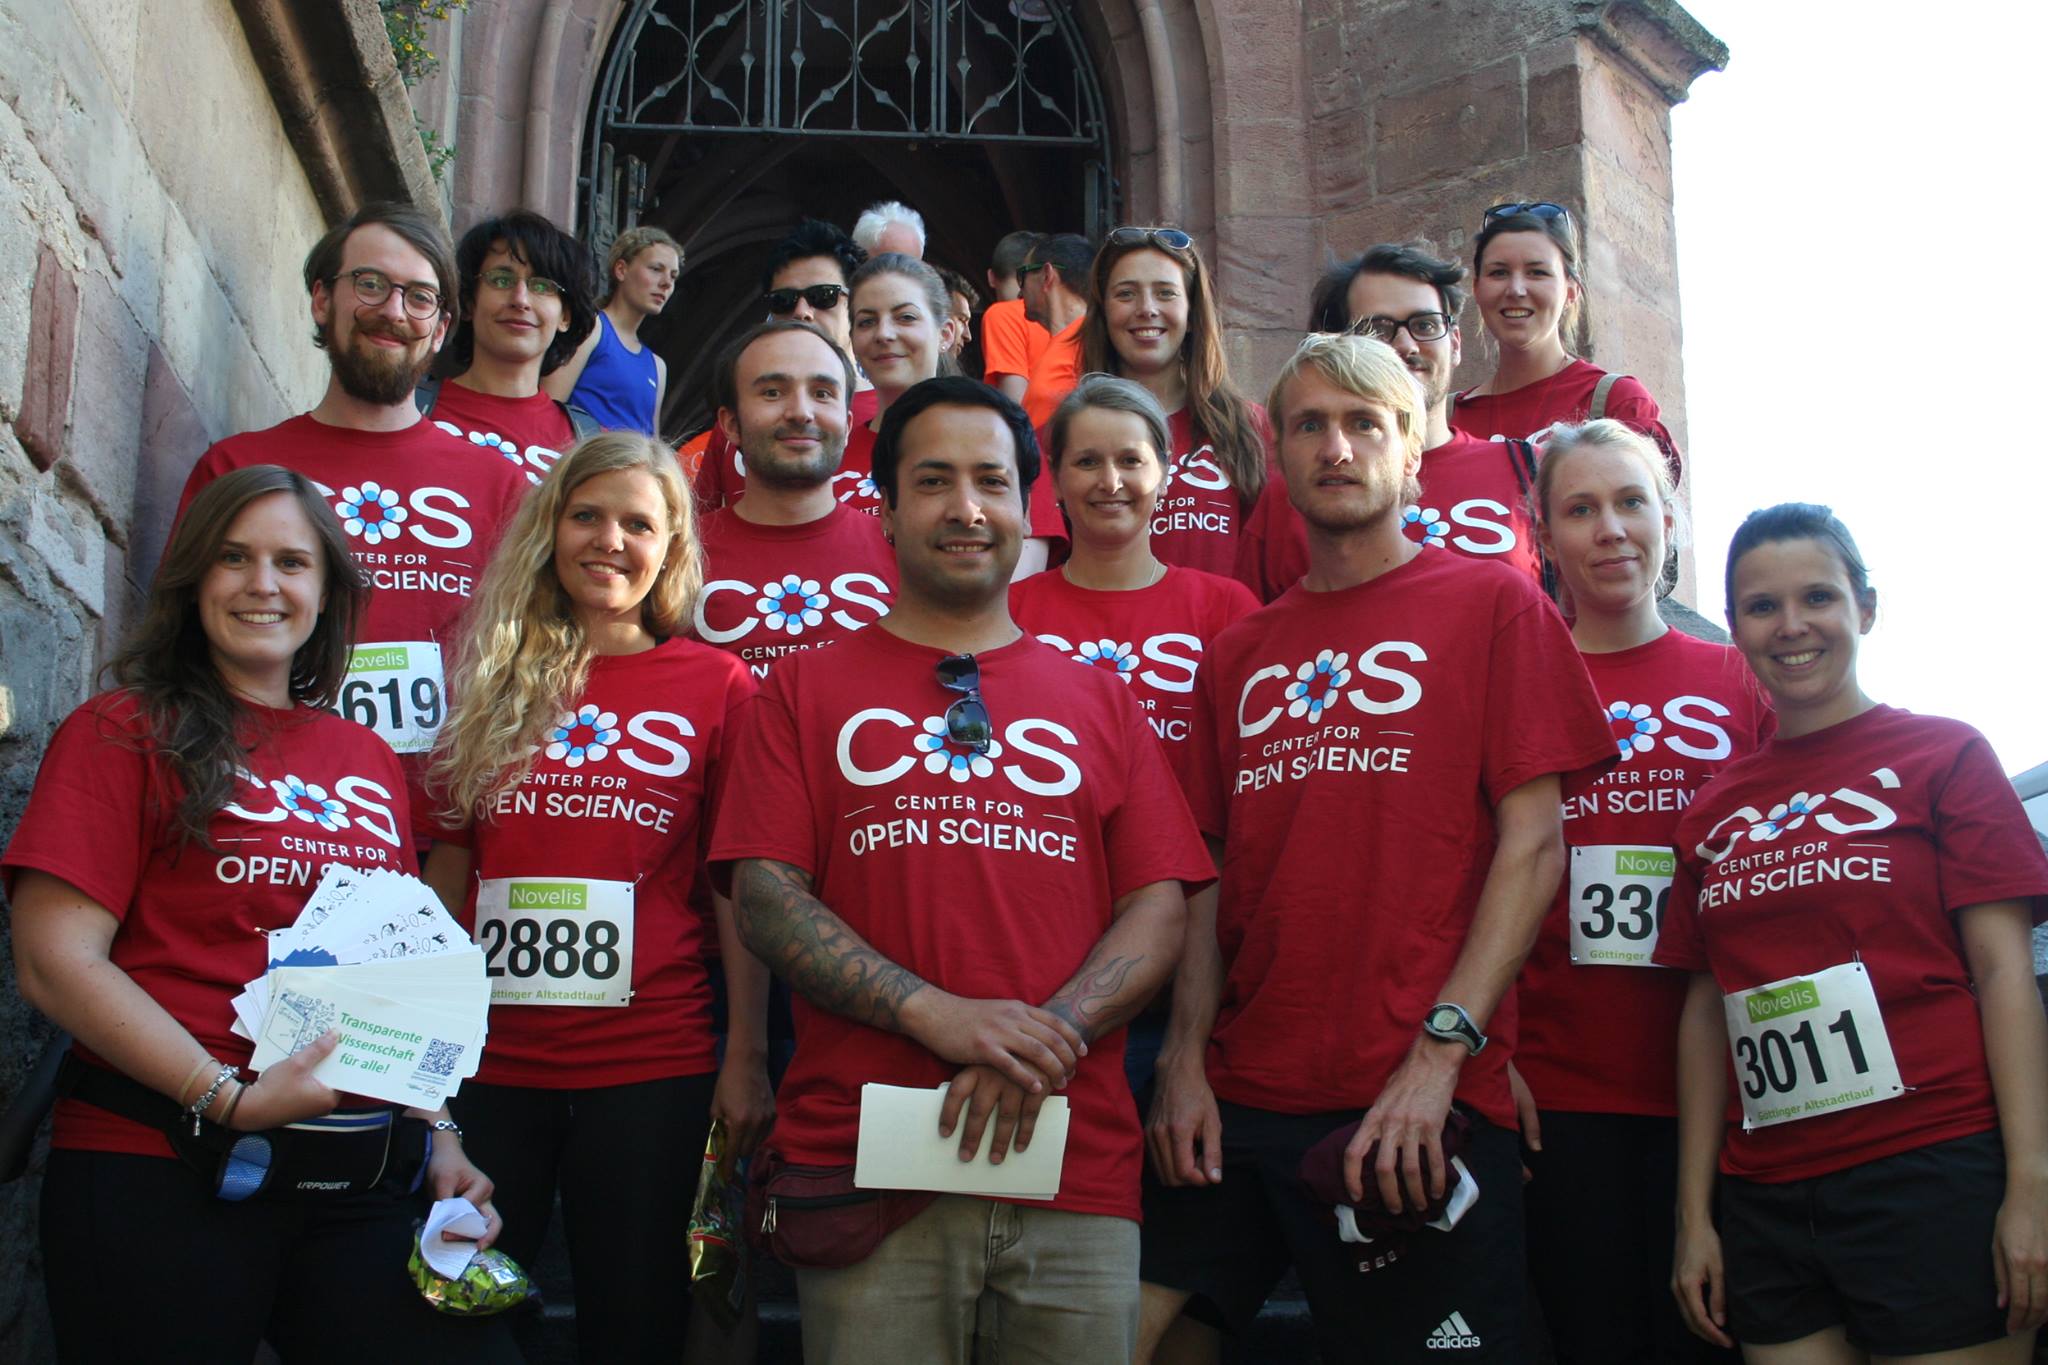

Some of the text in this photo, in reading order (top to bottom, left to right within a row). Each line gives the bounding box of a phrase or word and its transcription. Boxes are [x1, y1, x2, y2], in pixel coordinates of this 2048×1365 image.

[311, 481, 473, 549] OS
[1168, 496, 1196, 510] FOR
[1149, 512, 1231, 535] CIENCE
[394, 554, 427, 565] FOR
[330, 676, 441, 730] 619
[1262, 725, 1361, 758] CENTER FOR
[591, 776, 628, 790] FOR
[1233, 758, 1283, 795] PEN
[1648, 768, 1685, 783] FOR
[545, 793, 675, 834] SCIENCE
[894, 795, 1024, 818] CENTER FOR
[280, 835, 387, 863] CENTER FOR
[850, 818, 1078, 863] OPEN SCIENCE
[215, 855, 312, 887] OPEN
[1718, 841, 1829, 876] CENTER FOR
[511, 888, 583, 905] Novelis
[1698, 856, 1892, 915] PEN SCIENCE
[481, 918, 621, 980] 2888
[536, 989, 607, 1001] Altstadtlauf
[1750, 987, 1815, 1018] Novelis
[340, 1012, 423, 1044] Transparente
[339, 1052, 391, 1075] für alle!
[1736, 1008, 1870, 1100] 3011
[1804, 1086, 1876, 1112] Altstadtlauf
[1426, 1332, 1481, 1349] adidas
